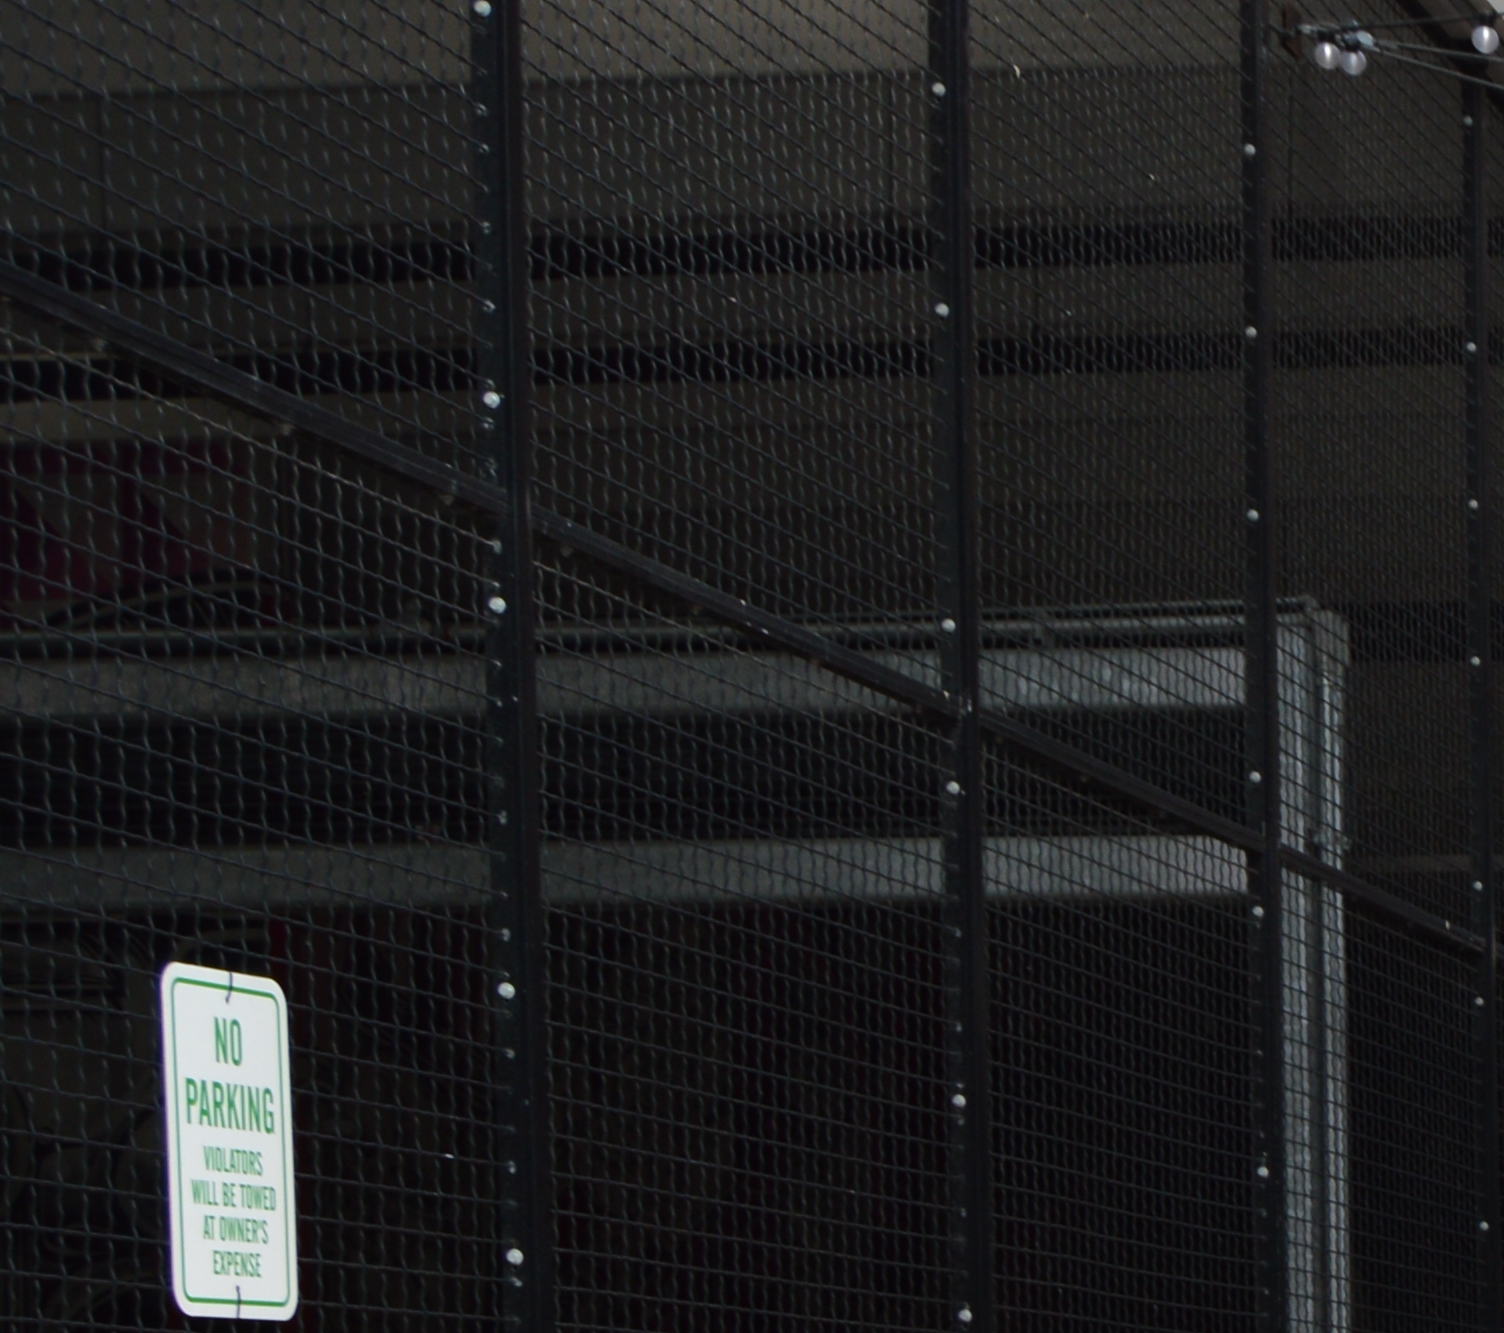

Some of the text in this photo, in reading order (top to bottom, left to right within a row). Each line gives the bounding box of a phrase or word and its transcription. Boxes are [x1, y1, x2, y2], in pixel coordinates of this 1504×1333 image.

[213, 1016, 242, 1066] NO
[185, 1077, 275, 1134] PARKING
[203, 1145, 263, 1176] VIOLATORS
[191, 1179, 276, 1211] WILL BE TOWED
[203, 1214, 269, 1245] AT OWNER'S
[213, 1249, 262, 1278] EXPENSE
